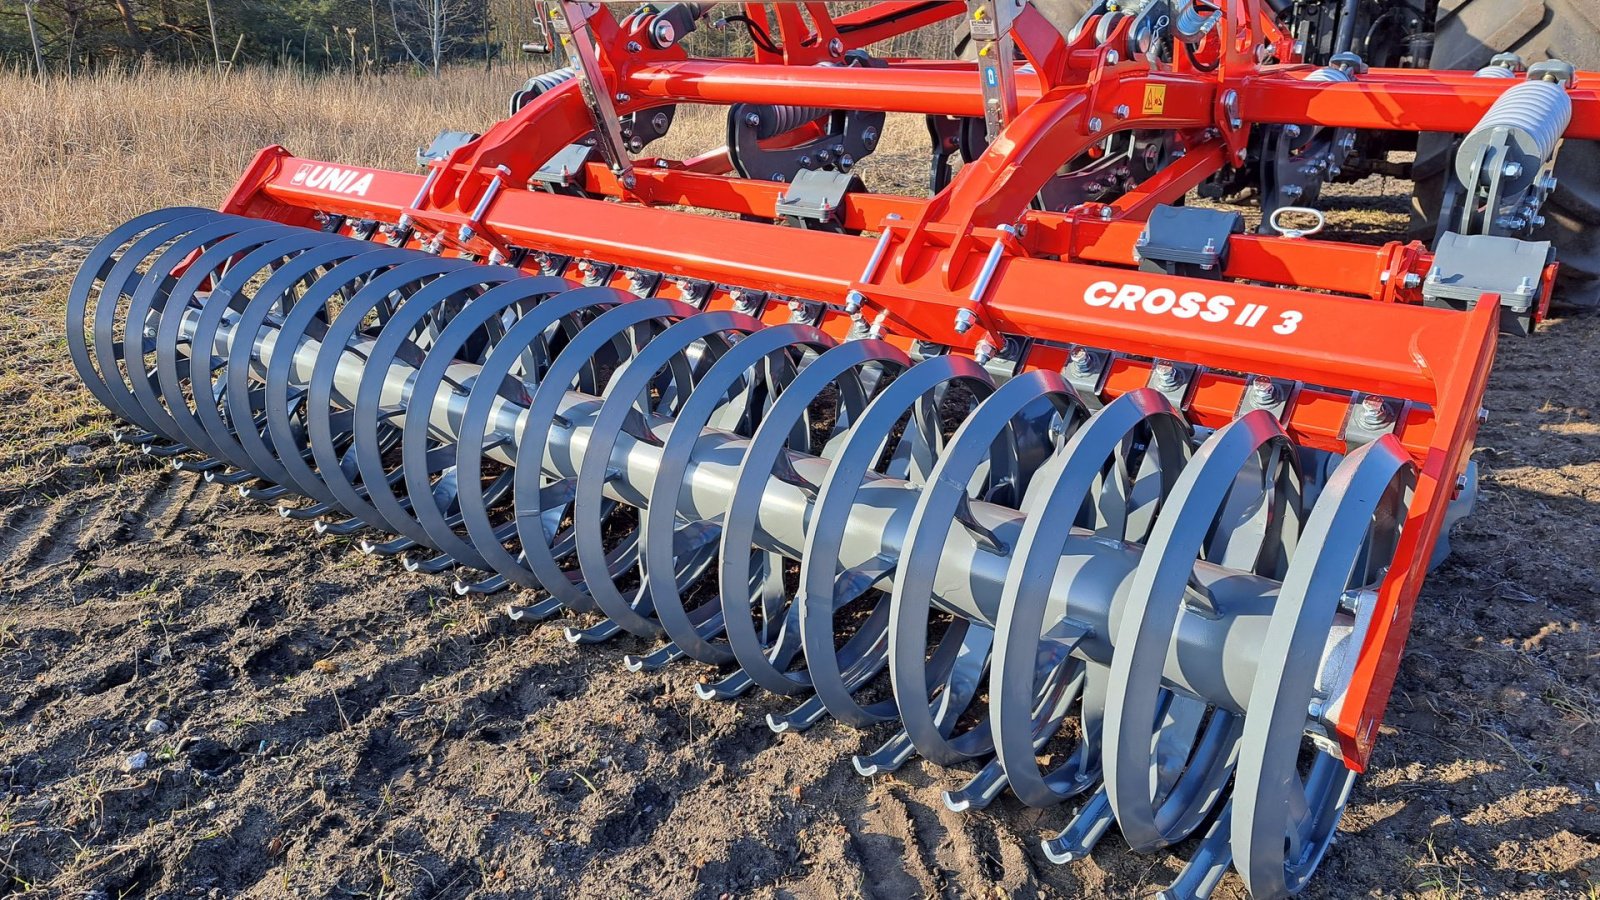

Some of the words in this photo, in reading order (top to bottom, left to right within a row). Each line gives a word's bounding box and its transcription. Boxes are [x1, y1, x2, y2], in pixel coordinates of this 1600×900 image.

[304, 165, 374, 197] UNIA
[1083, 281, 1236, 323] CROSS
[1272, 310, 1303, 335] 3
